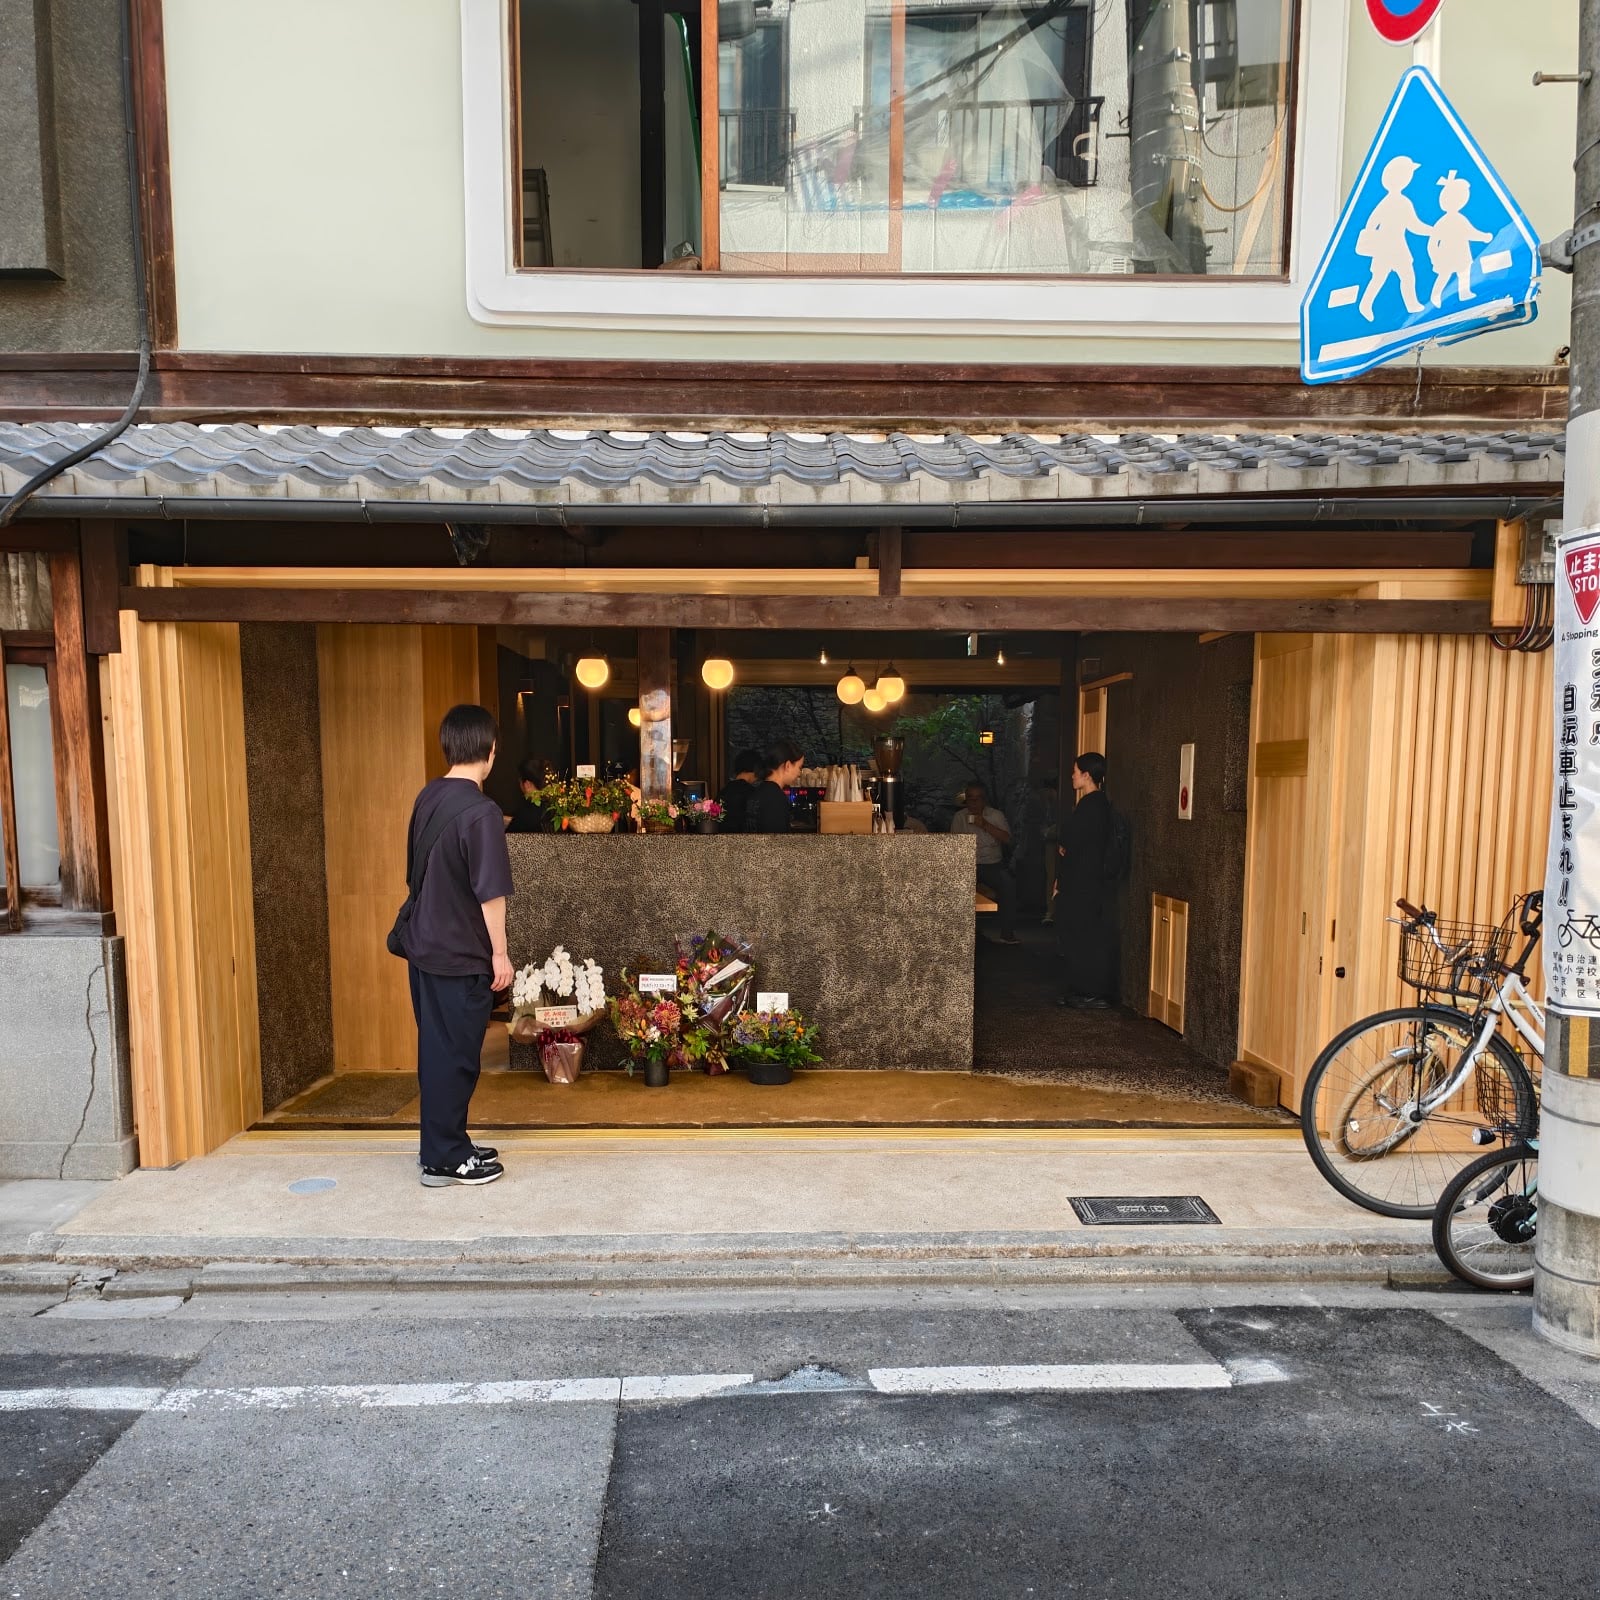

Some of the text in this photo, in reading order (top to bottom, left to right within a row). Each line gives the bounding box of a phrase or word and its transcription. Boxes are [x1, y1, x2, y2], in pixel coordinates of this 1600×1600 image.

[1569, 552, 1600, 576] 止ま
[1574, 575, 1600, 594] STO
[1566, 627, 1598, 641] Stopping
